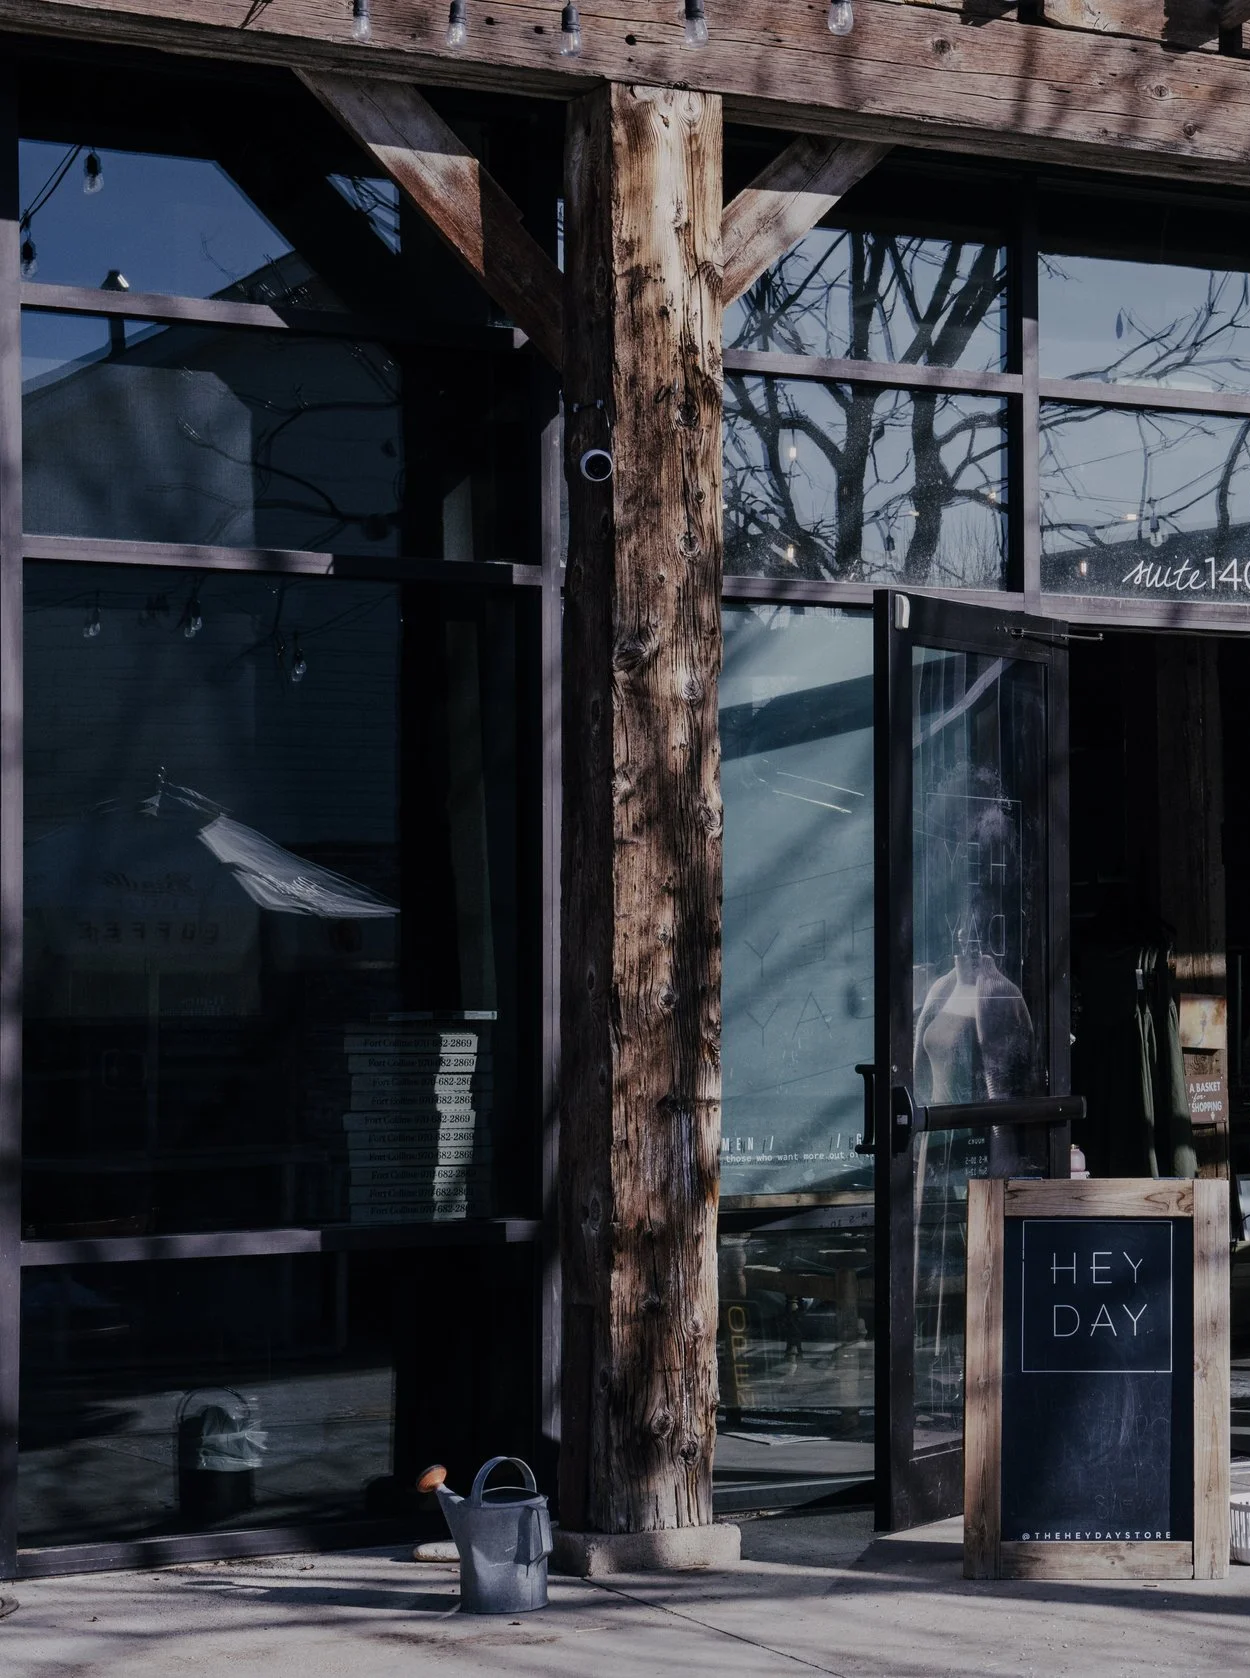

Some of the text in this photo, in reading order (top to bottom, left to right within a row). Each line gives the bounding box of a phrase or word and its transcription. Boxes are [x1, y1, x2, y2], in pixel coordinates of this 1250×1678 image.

[1189, 1081, 1221, 1093] A BASKET
[1191, 1101, 1222, 1113] SHOPPING
[726, 1152, 751, 1163] those
[756, 1154, 773, 1162] who
[778, 1153, 799, 1161] want
[803, 1152, 825, 1160] more
[829, 1151, 845, 1160] out
[1050, 1252, 1144, 1285] HEY
[1053, 1303, 1148, 1337] DAY
[1021, 1531, 1171, 1541] @THEHEYDAYSTORE
